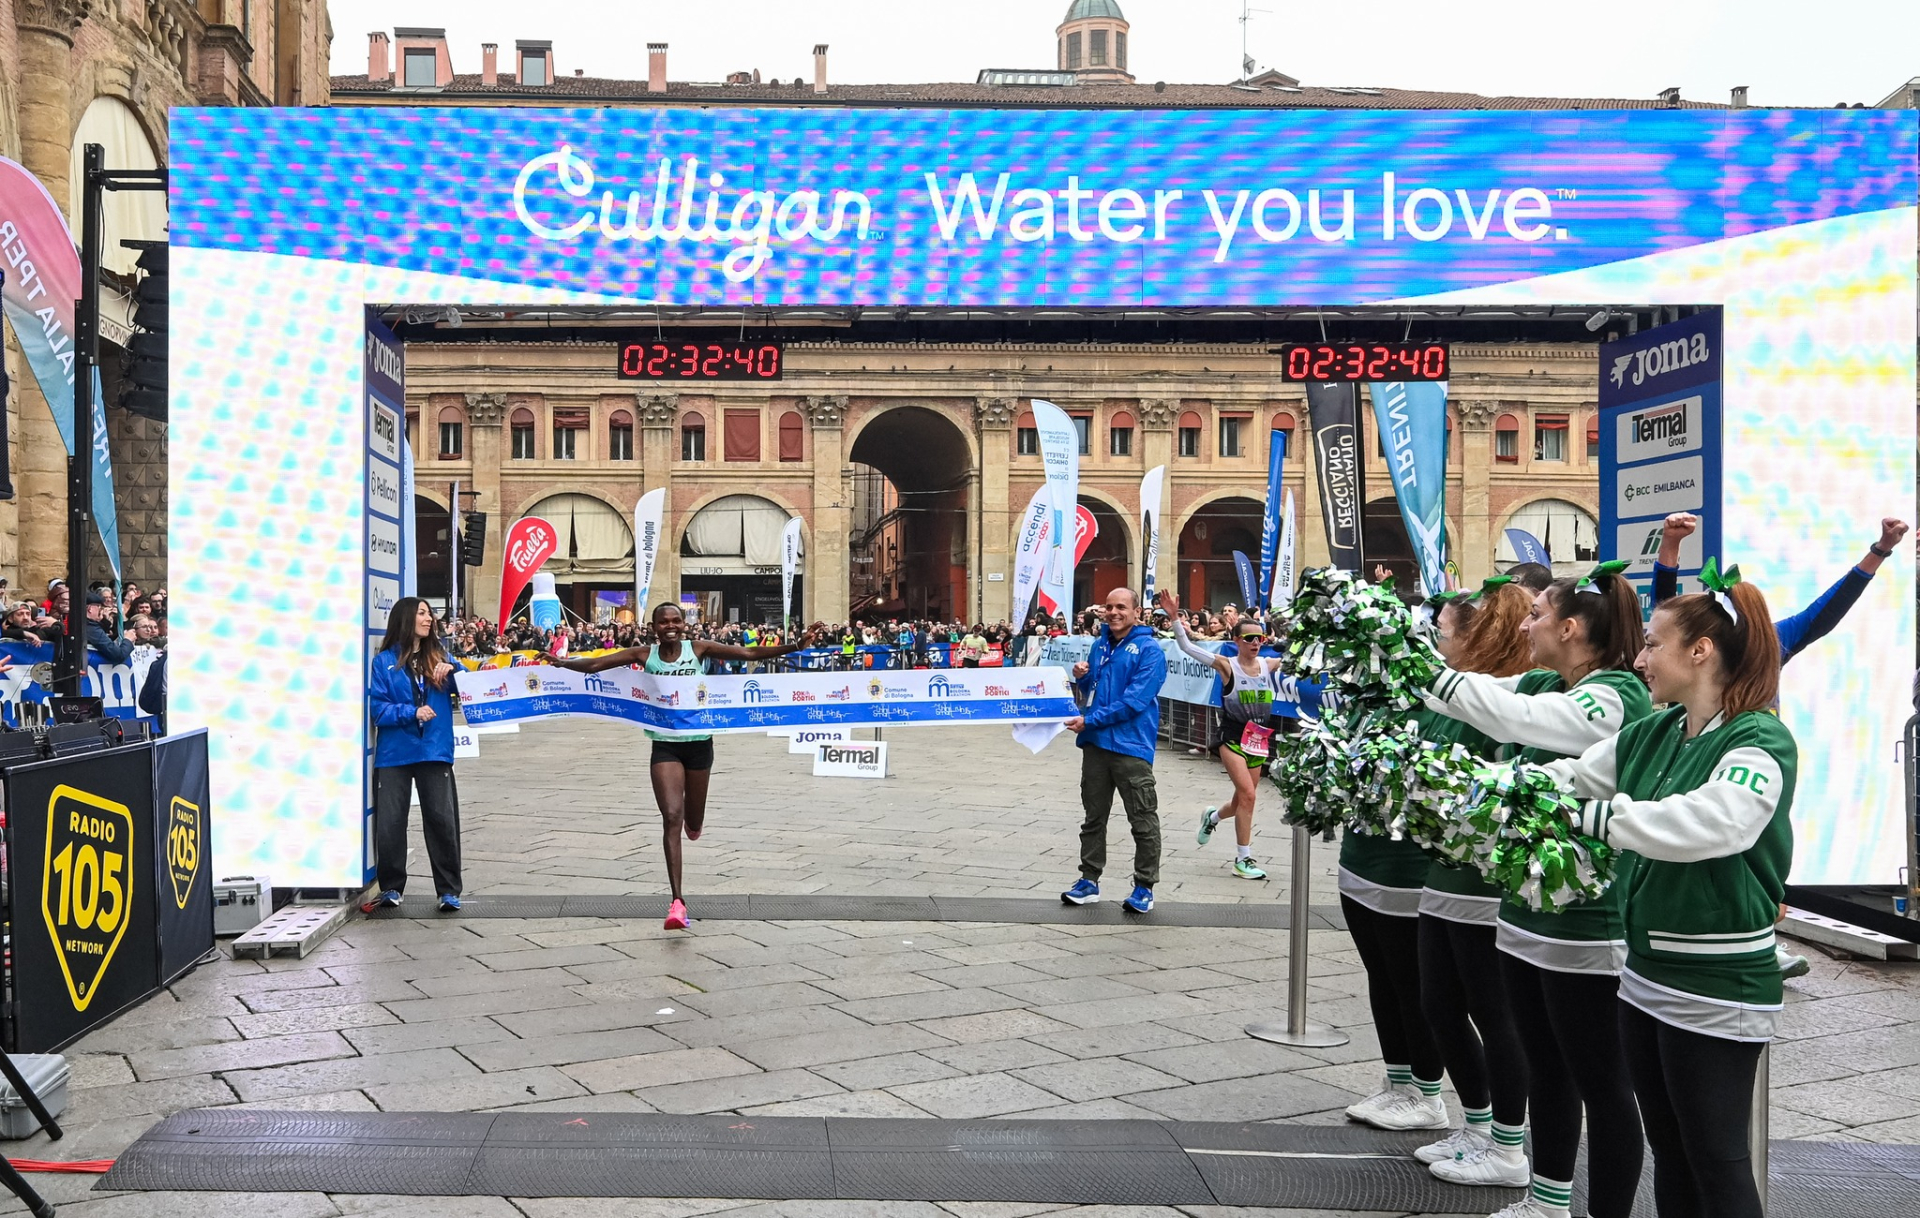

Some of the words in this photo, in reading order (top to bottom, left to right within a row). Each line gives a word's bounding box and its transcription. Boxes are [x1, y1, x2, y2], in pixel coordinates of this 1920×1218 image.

[513, 144, 872, 283] Culligan
[924, 172, 1182, 242] Water
[1201, 188, 1355, 263] you
[1383, 171, 1568, 242] love.
[623, 345, 779, 377] 02:32:40
[1288, 346, 1445, 379] 02:32:40
[373, 402, 395, 443] Termal
[1634, 403, 1688, 443] Termal
[1668, 437, 1688, 448] Group
[376, 476, 398, 502] Pelliconi
[1636, 485, 1651, 497] BCC
[1653, 478, 1696, 494] EMILBANCA
[1023, 501, 1047, 552] accendi
[377, 538, 397, 555] HYUNDAI
[820, 744, 879, 764] Termal
[857, 763, 878, 772] Group
[69, 810, 116, 843] RADIO
[176, 808, 194, 825] RADIO
[170, 824, 197, 871] 105
[53, 840, 123, 933] 105
[175, 872, 190, 883] NETWORK
[66, 939, 104, 956] NETWORK
